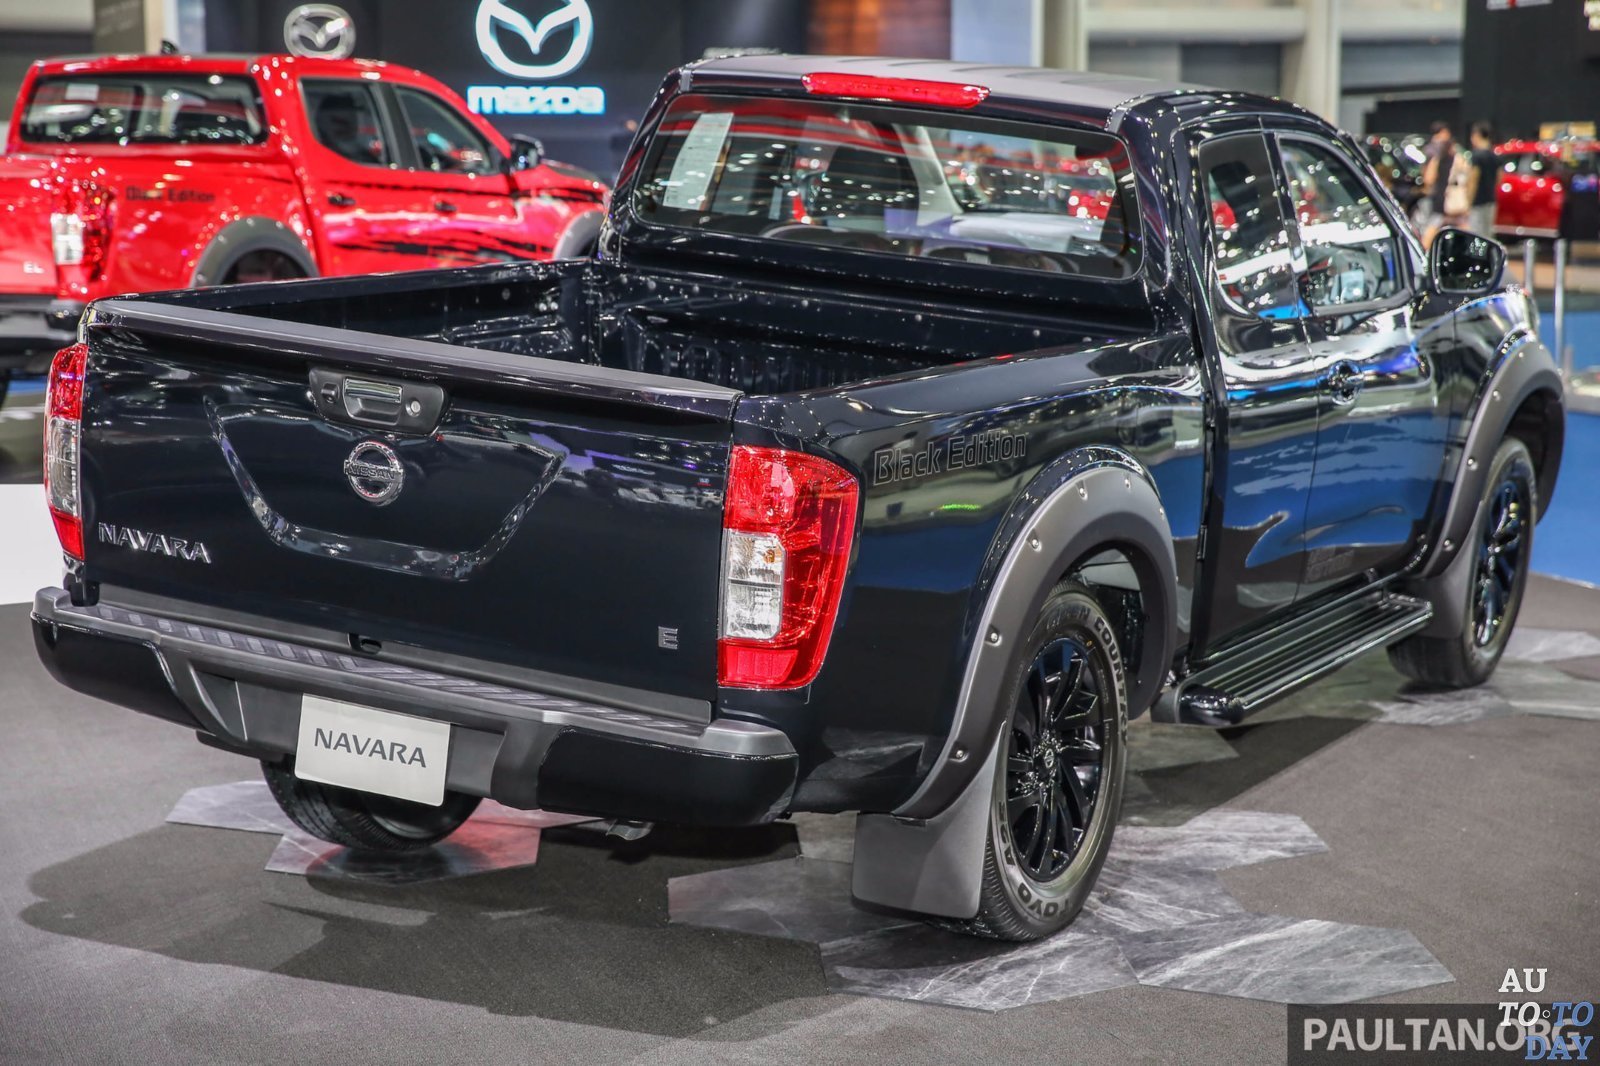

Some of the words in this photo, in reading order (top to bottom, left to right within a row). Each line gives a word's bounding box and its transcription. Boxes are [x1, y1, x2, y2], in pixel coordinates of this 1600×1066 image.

[346, 461, 396, 481] NISSAN
[873, 441, 942, 486] Black
[947, 429, 1027, 471] Edition
[99, 522, 212, 564] NAVARA
[658, 626, 679, 650] E
[314, 727, 427, 768] NAVARA
